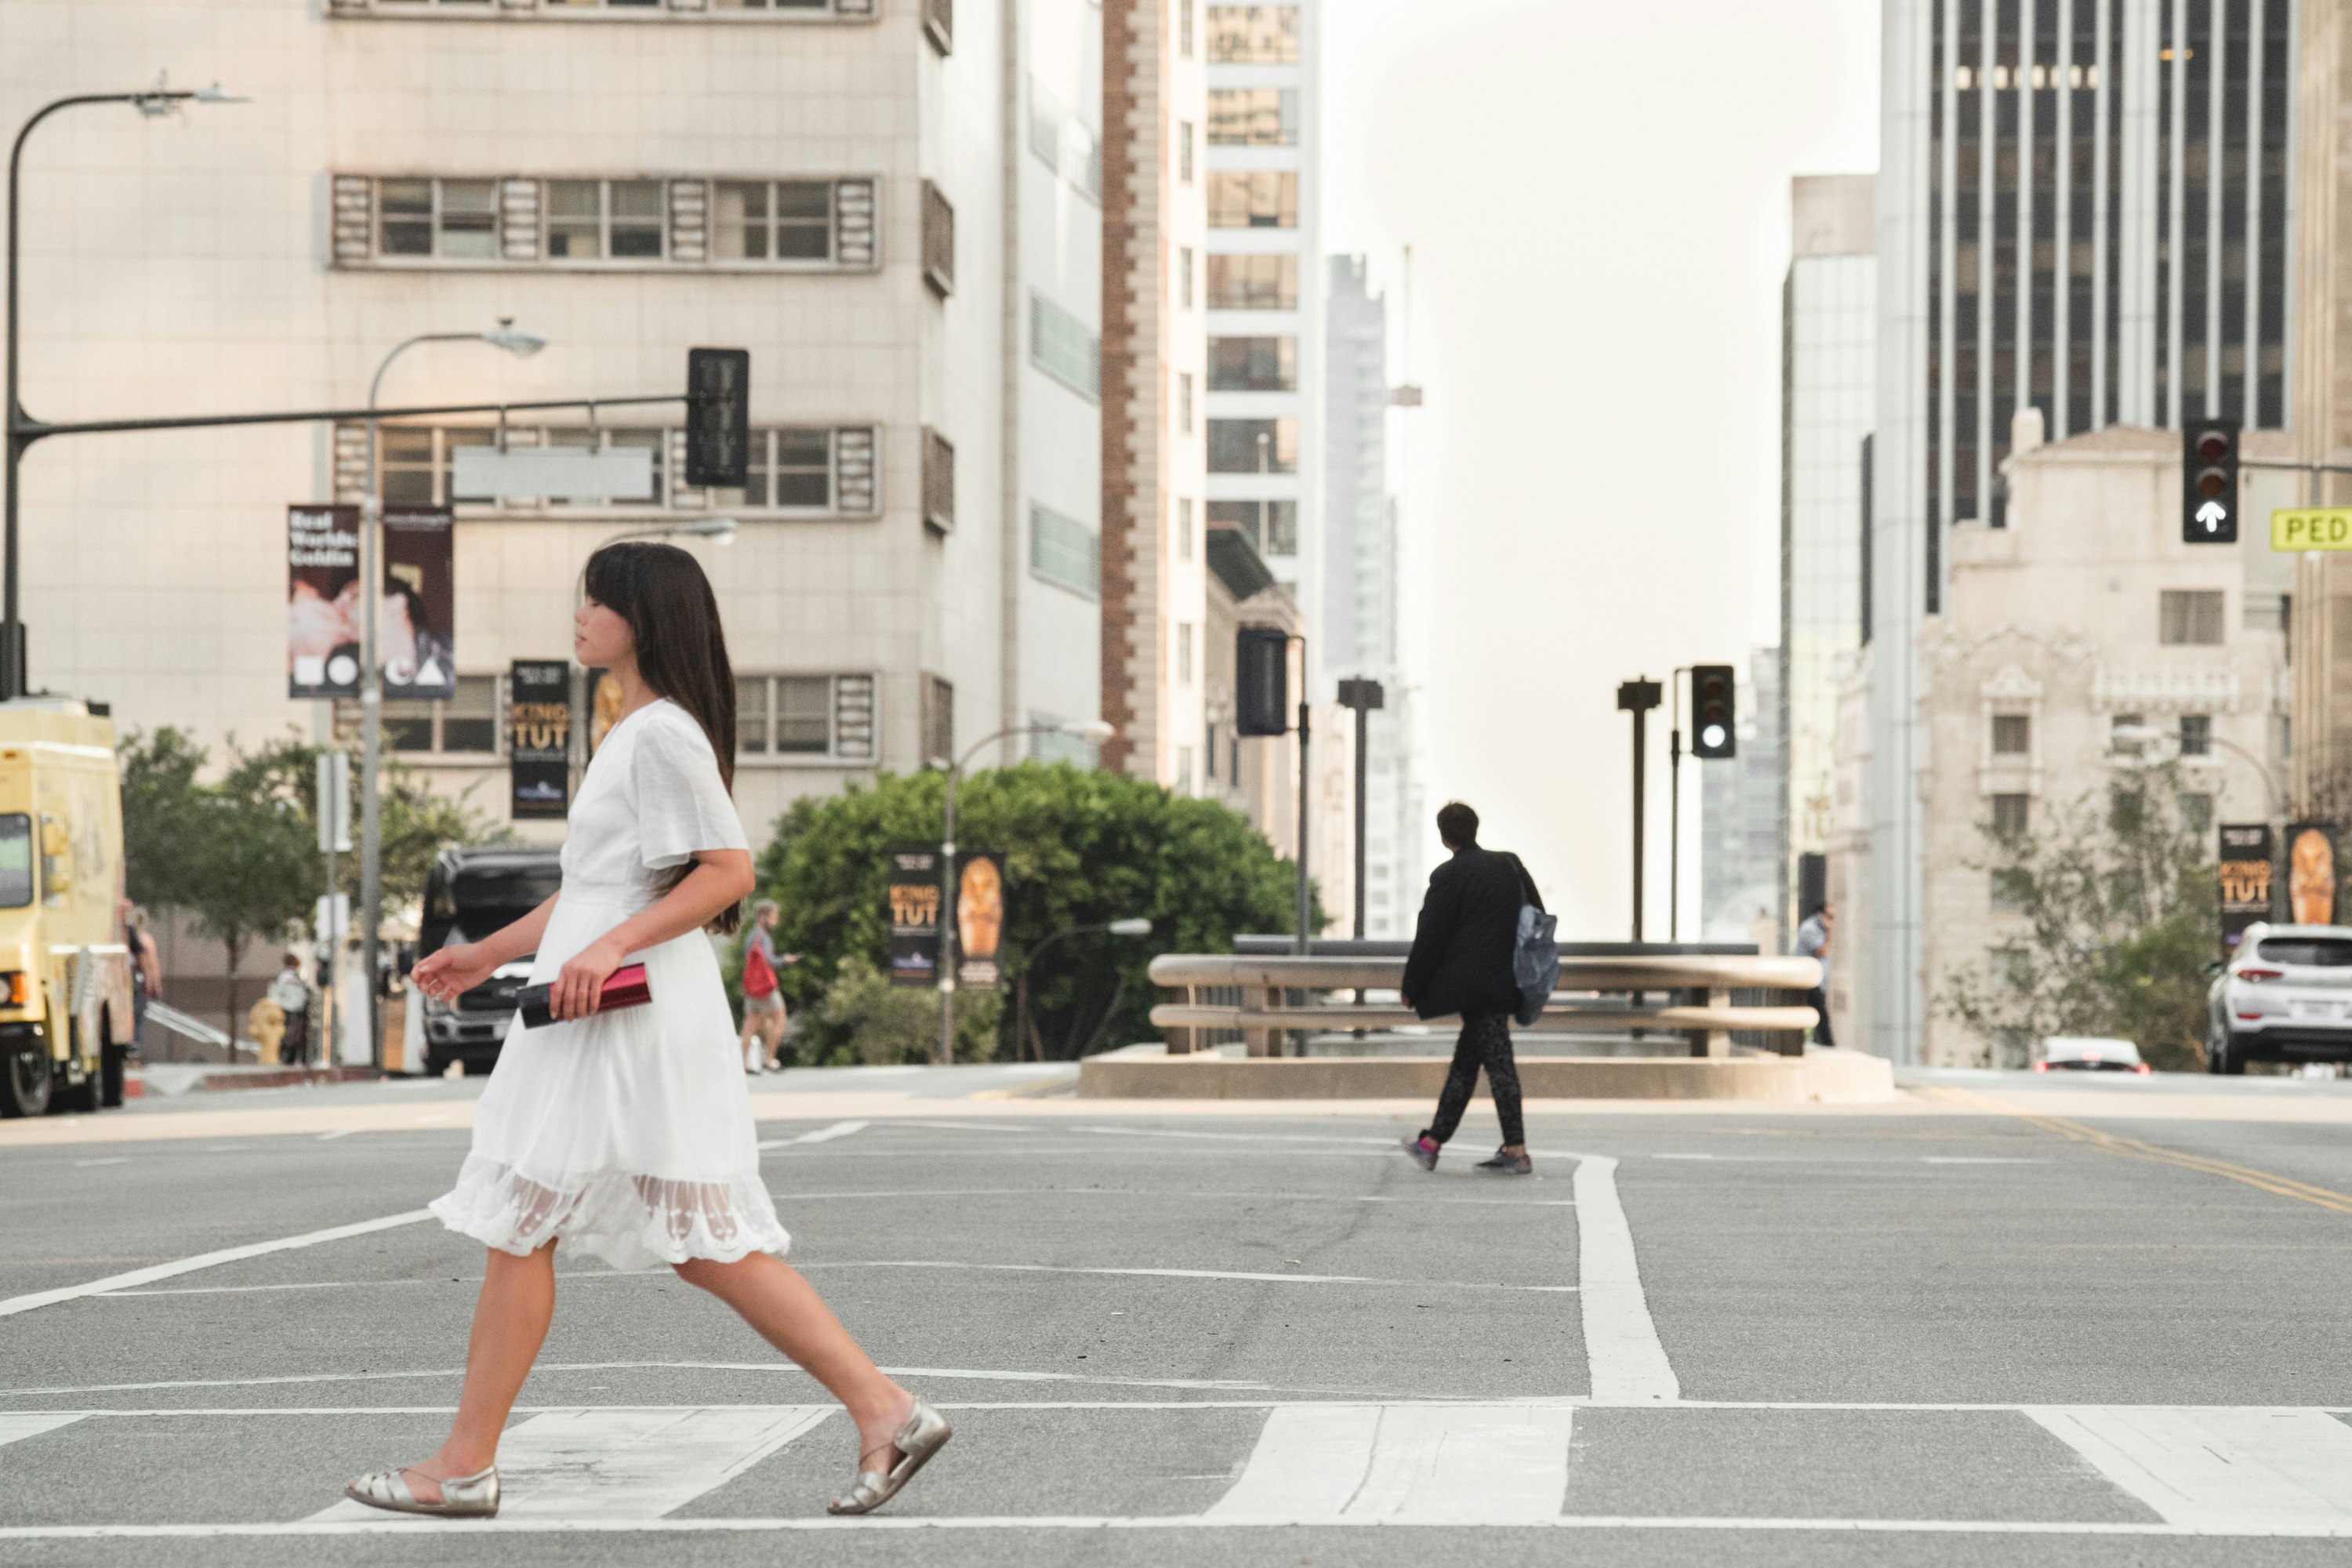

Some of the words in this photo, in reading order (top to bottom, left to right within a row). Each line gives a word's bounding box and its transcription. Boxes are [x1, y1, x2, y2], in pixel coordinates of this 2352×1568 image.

[291, 510, 332, 528] Real
[2287, 517, 2347, 543] PED
[514, 702, 569, 721] KING
[514, 721, 568, 750] TUT
[2219, 860, 2270, 879] KING
[890, 884, 939, 902] KING
[2220, 878, 2269, 902] TUT
[891, 902, 938, 926] TUT
